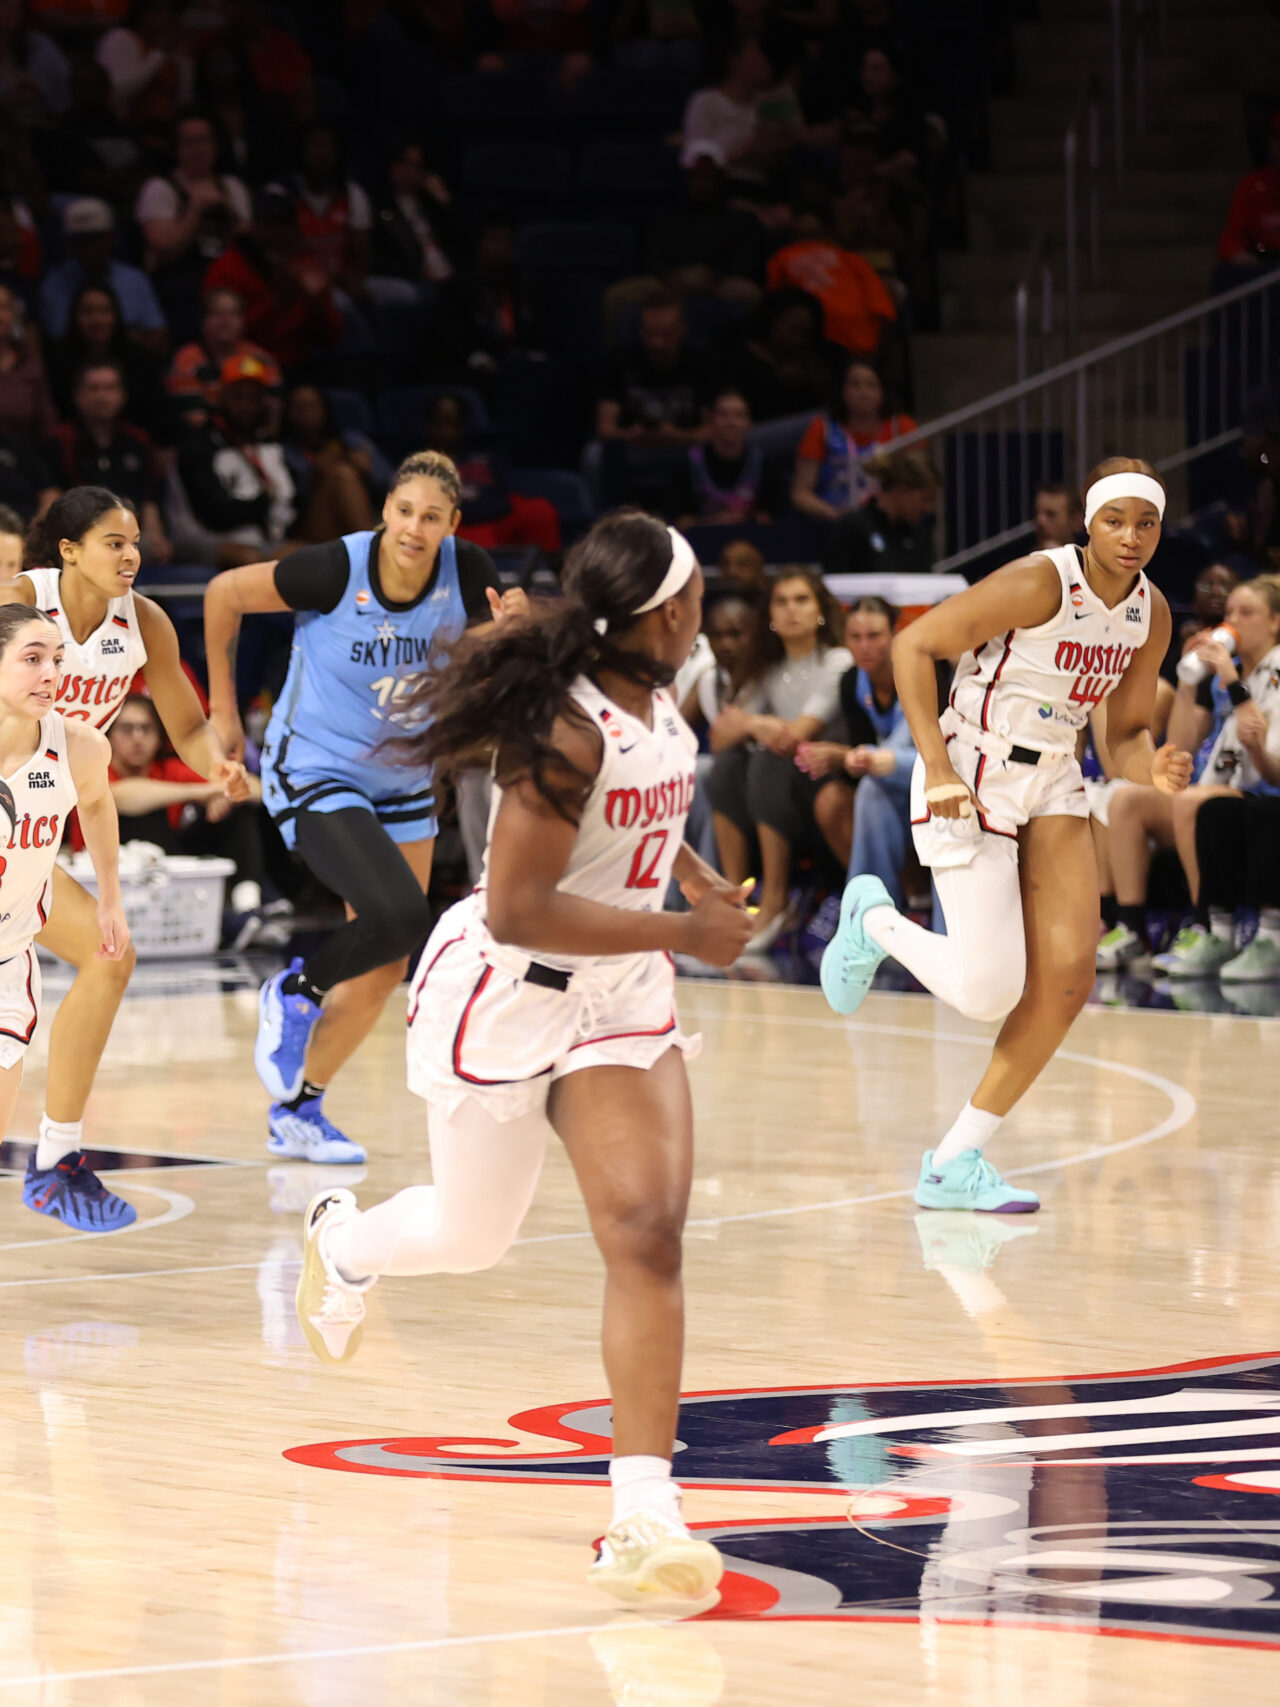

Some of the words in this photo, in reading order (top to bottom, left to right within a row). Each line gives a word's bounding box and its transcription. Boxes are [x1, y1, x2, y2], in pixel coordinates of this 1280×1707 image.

[101, 638, 120, 647] CAR
[101, 646, 125, 655] max
[350, 635, 431, 668] SKYTOW
[1068, 676, 1113, 709] 44
[28, 771, 50, 780] CAR
[28, 780, 56, 789] max
[625, 829, 669, 889] 12
